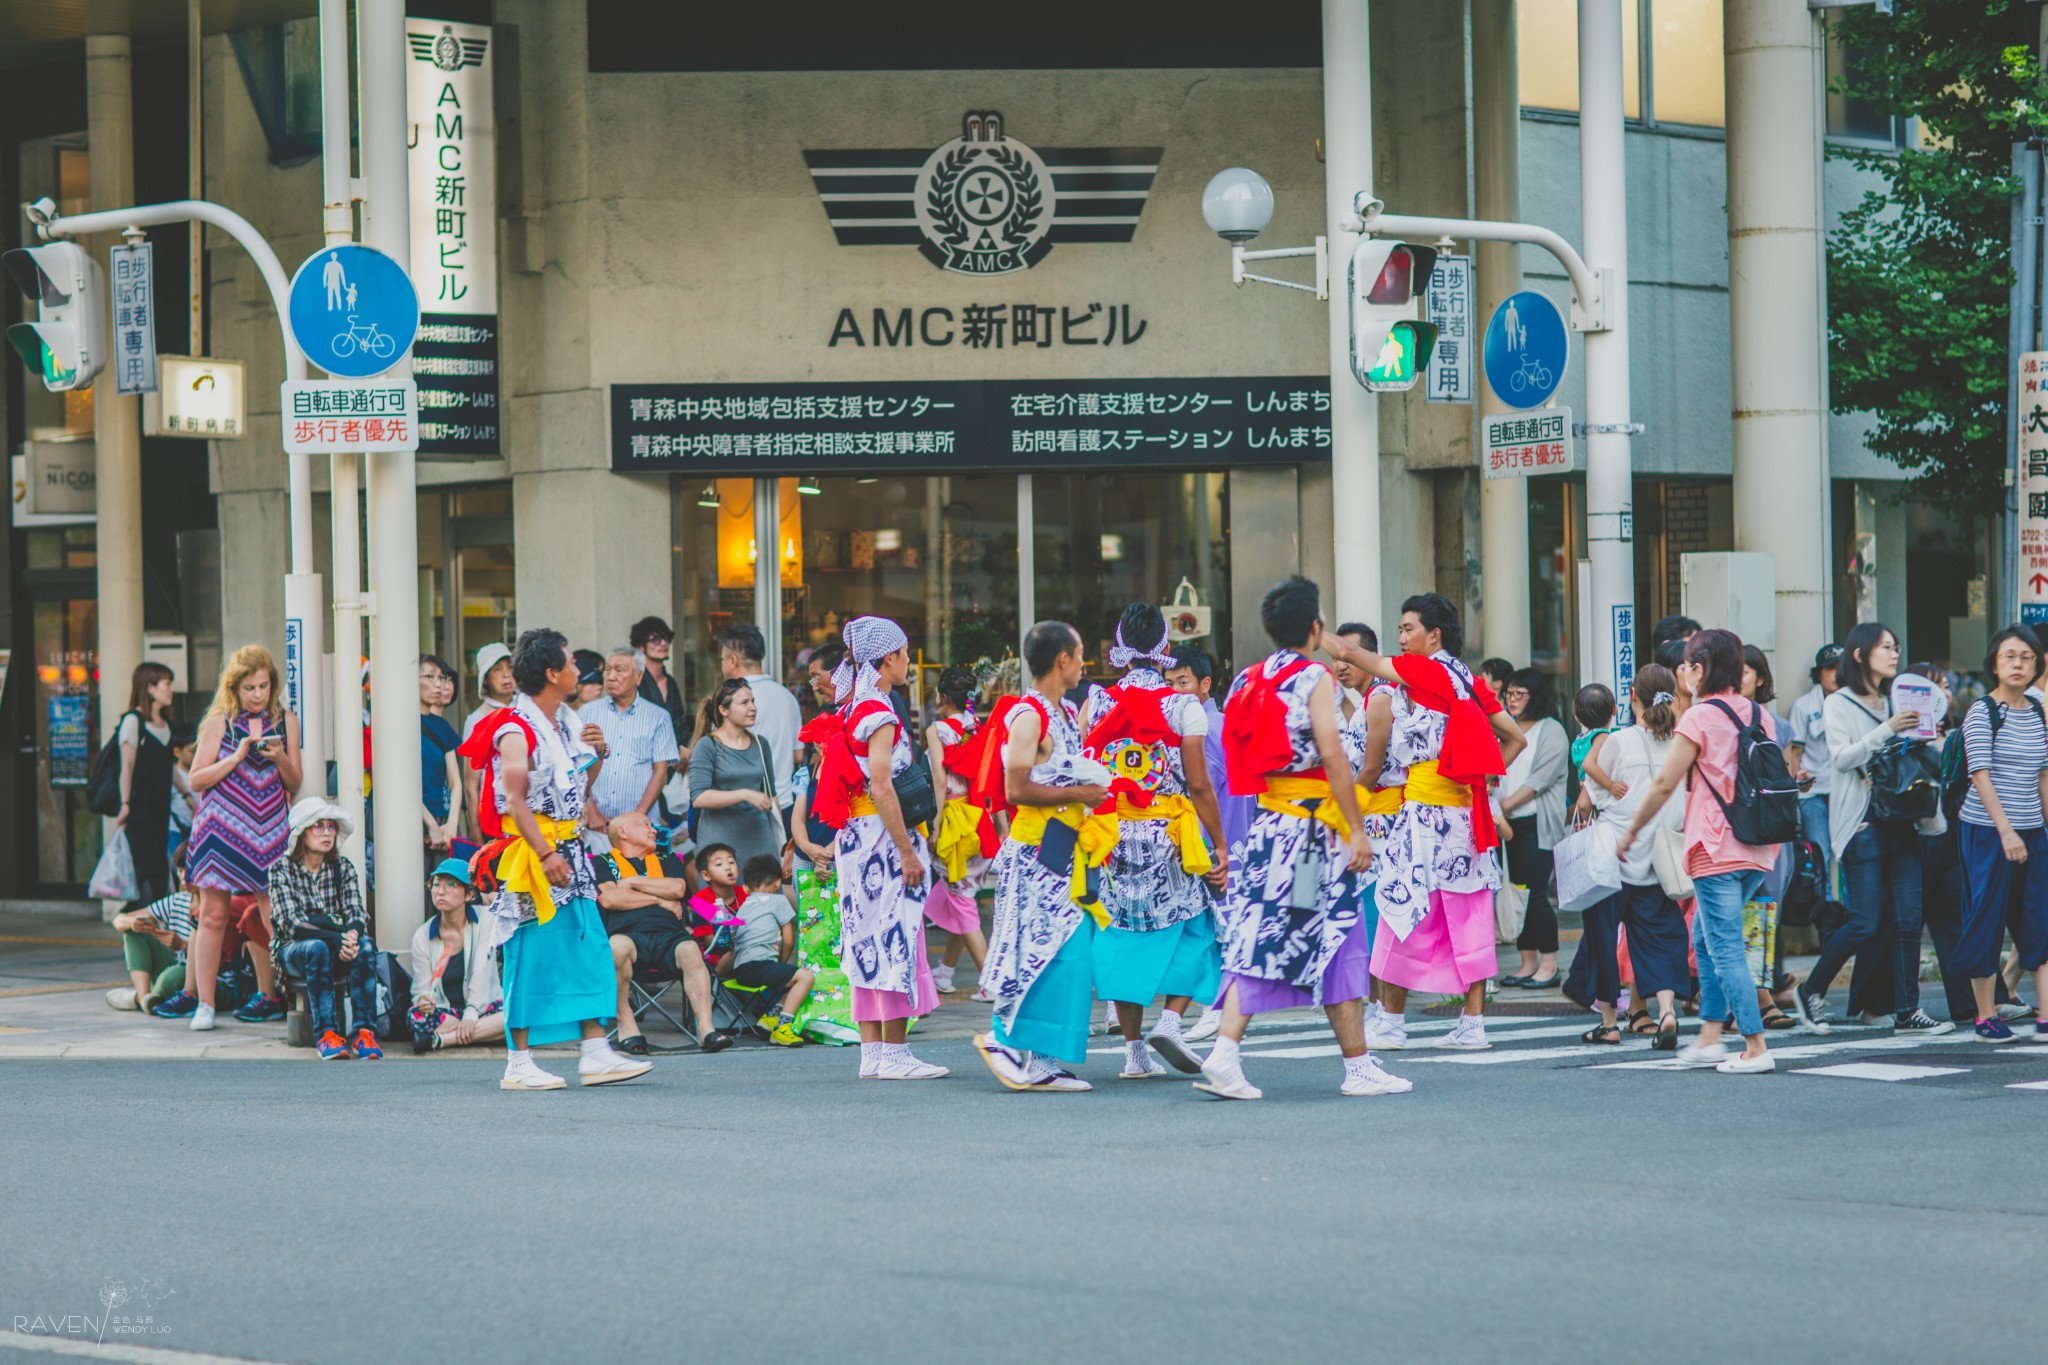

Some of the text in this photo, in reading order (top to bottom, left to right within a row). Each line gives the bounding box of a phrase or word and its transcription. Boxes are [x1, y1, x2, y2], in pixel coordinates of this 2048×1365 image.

[435, 82, 468, 301] AMC新町ビル
[959, 252, 1013, 272] AMC
[117, 259, 132, 328] 自転車
[132, 257, 147, 327] 歩行者
[1448, 267, 1465, 337] 歩行者
[828, 302, 1148, 349] AMC新町ビル
[124, 331, 144, 383] 専用
[1438, 340, 1460, 393] 専用
[293, 388, 407, 414] 自転車通行可
[630, 396, 955, 421] 青森中央地域包括支援センター
[1011, 390, 1331, 416] 在宅介護支援センター しんまち
[294, 418, 408, 444] 歩行者優先
[630, 430, 956, 458] 青森中央障害者指定相談支援事業所
[1011, 426, 1331, 453] 訪問看護ステーション しんまち
[1489, 416, 1564, 444] 自転車通行可
[1490, 444, 1566, 471] 歩行者優先
